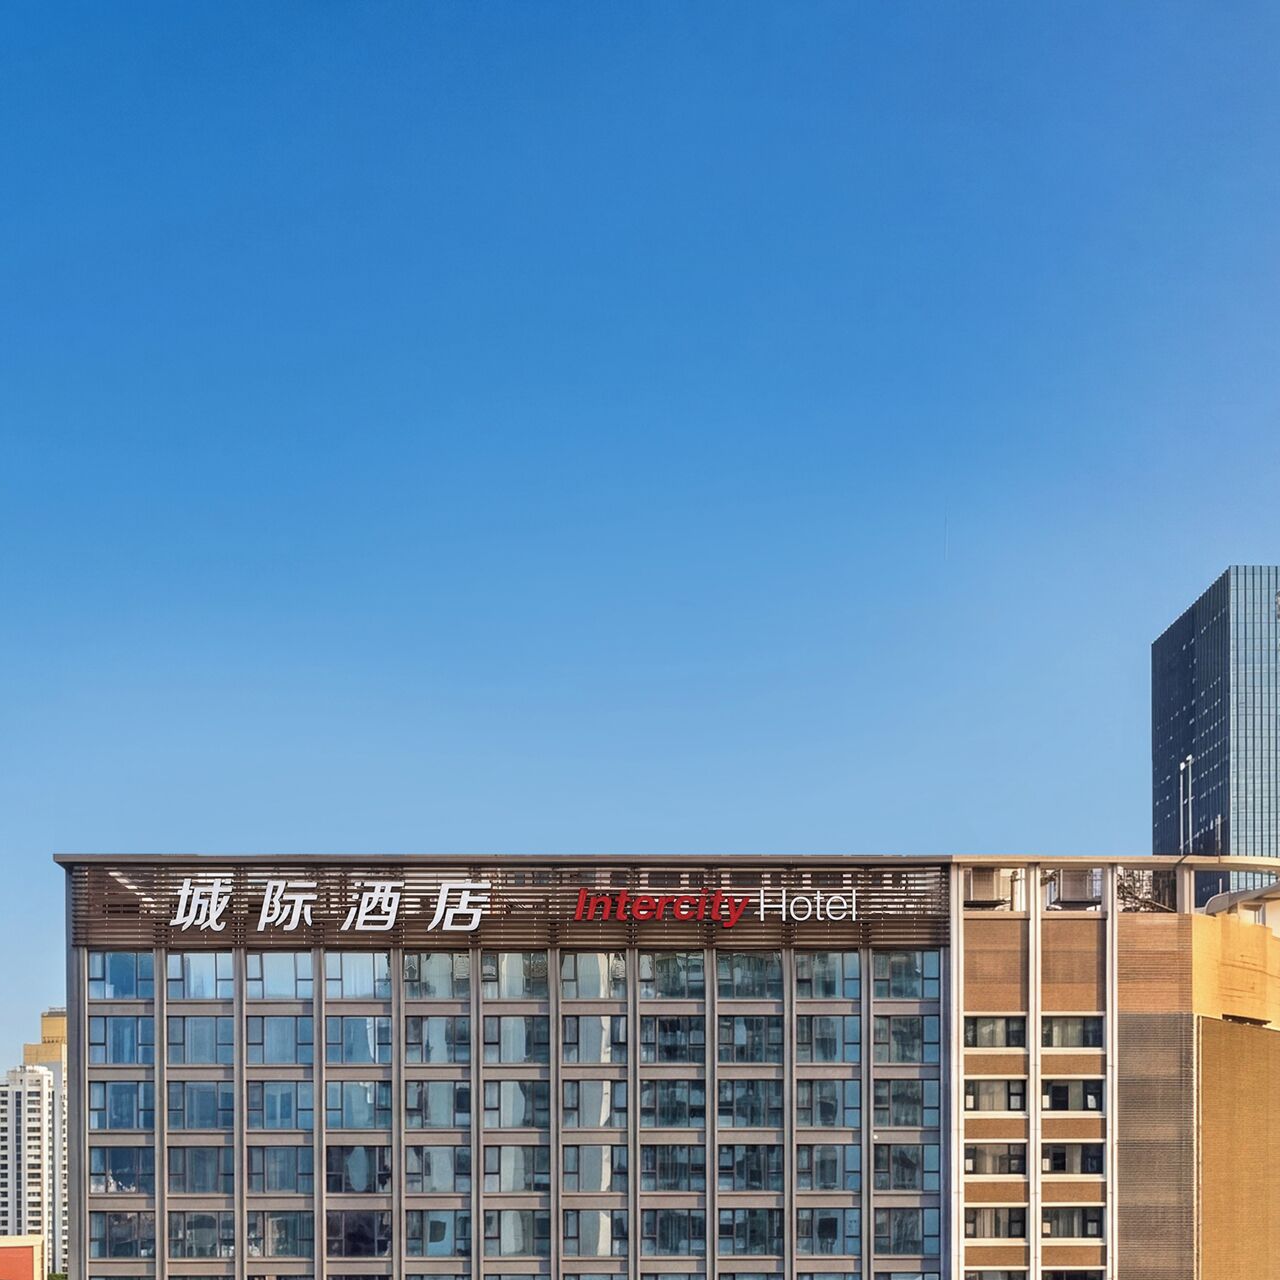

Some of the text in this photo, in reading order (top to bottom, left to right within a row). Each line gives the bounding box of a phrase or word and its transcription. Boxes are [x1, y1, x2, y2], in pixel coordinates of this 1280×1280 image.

[169, 878, 857, 931] 城际酒店 Intercity Hotel
